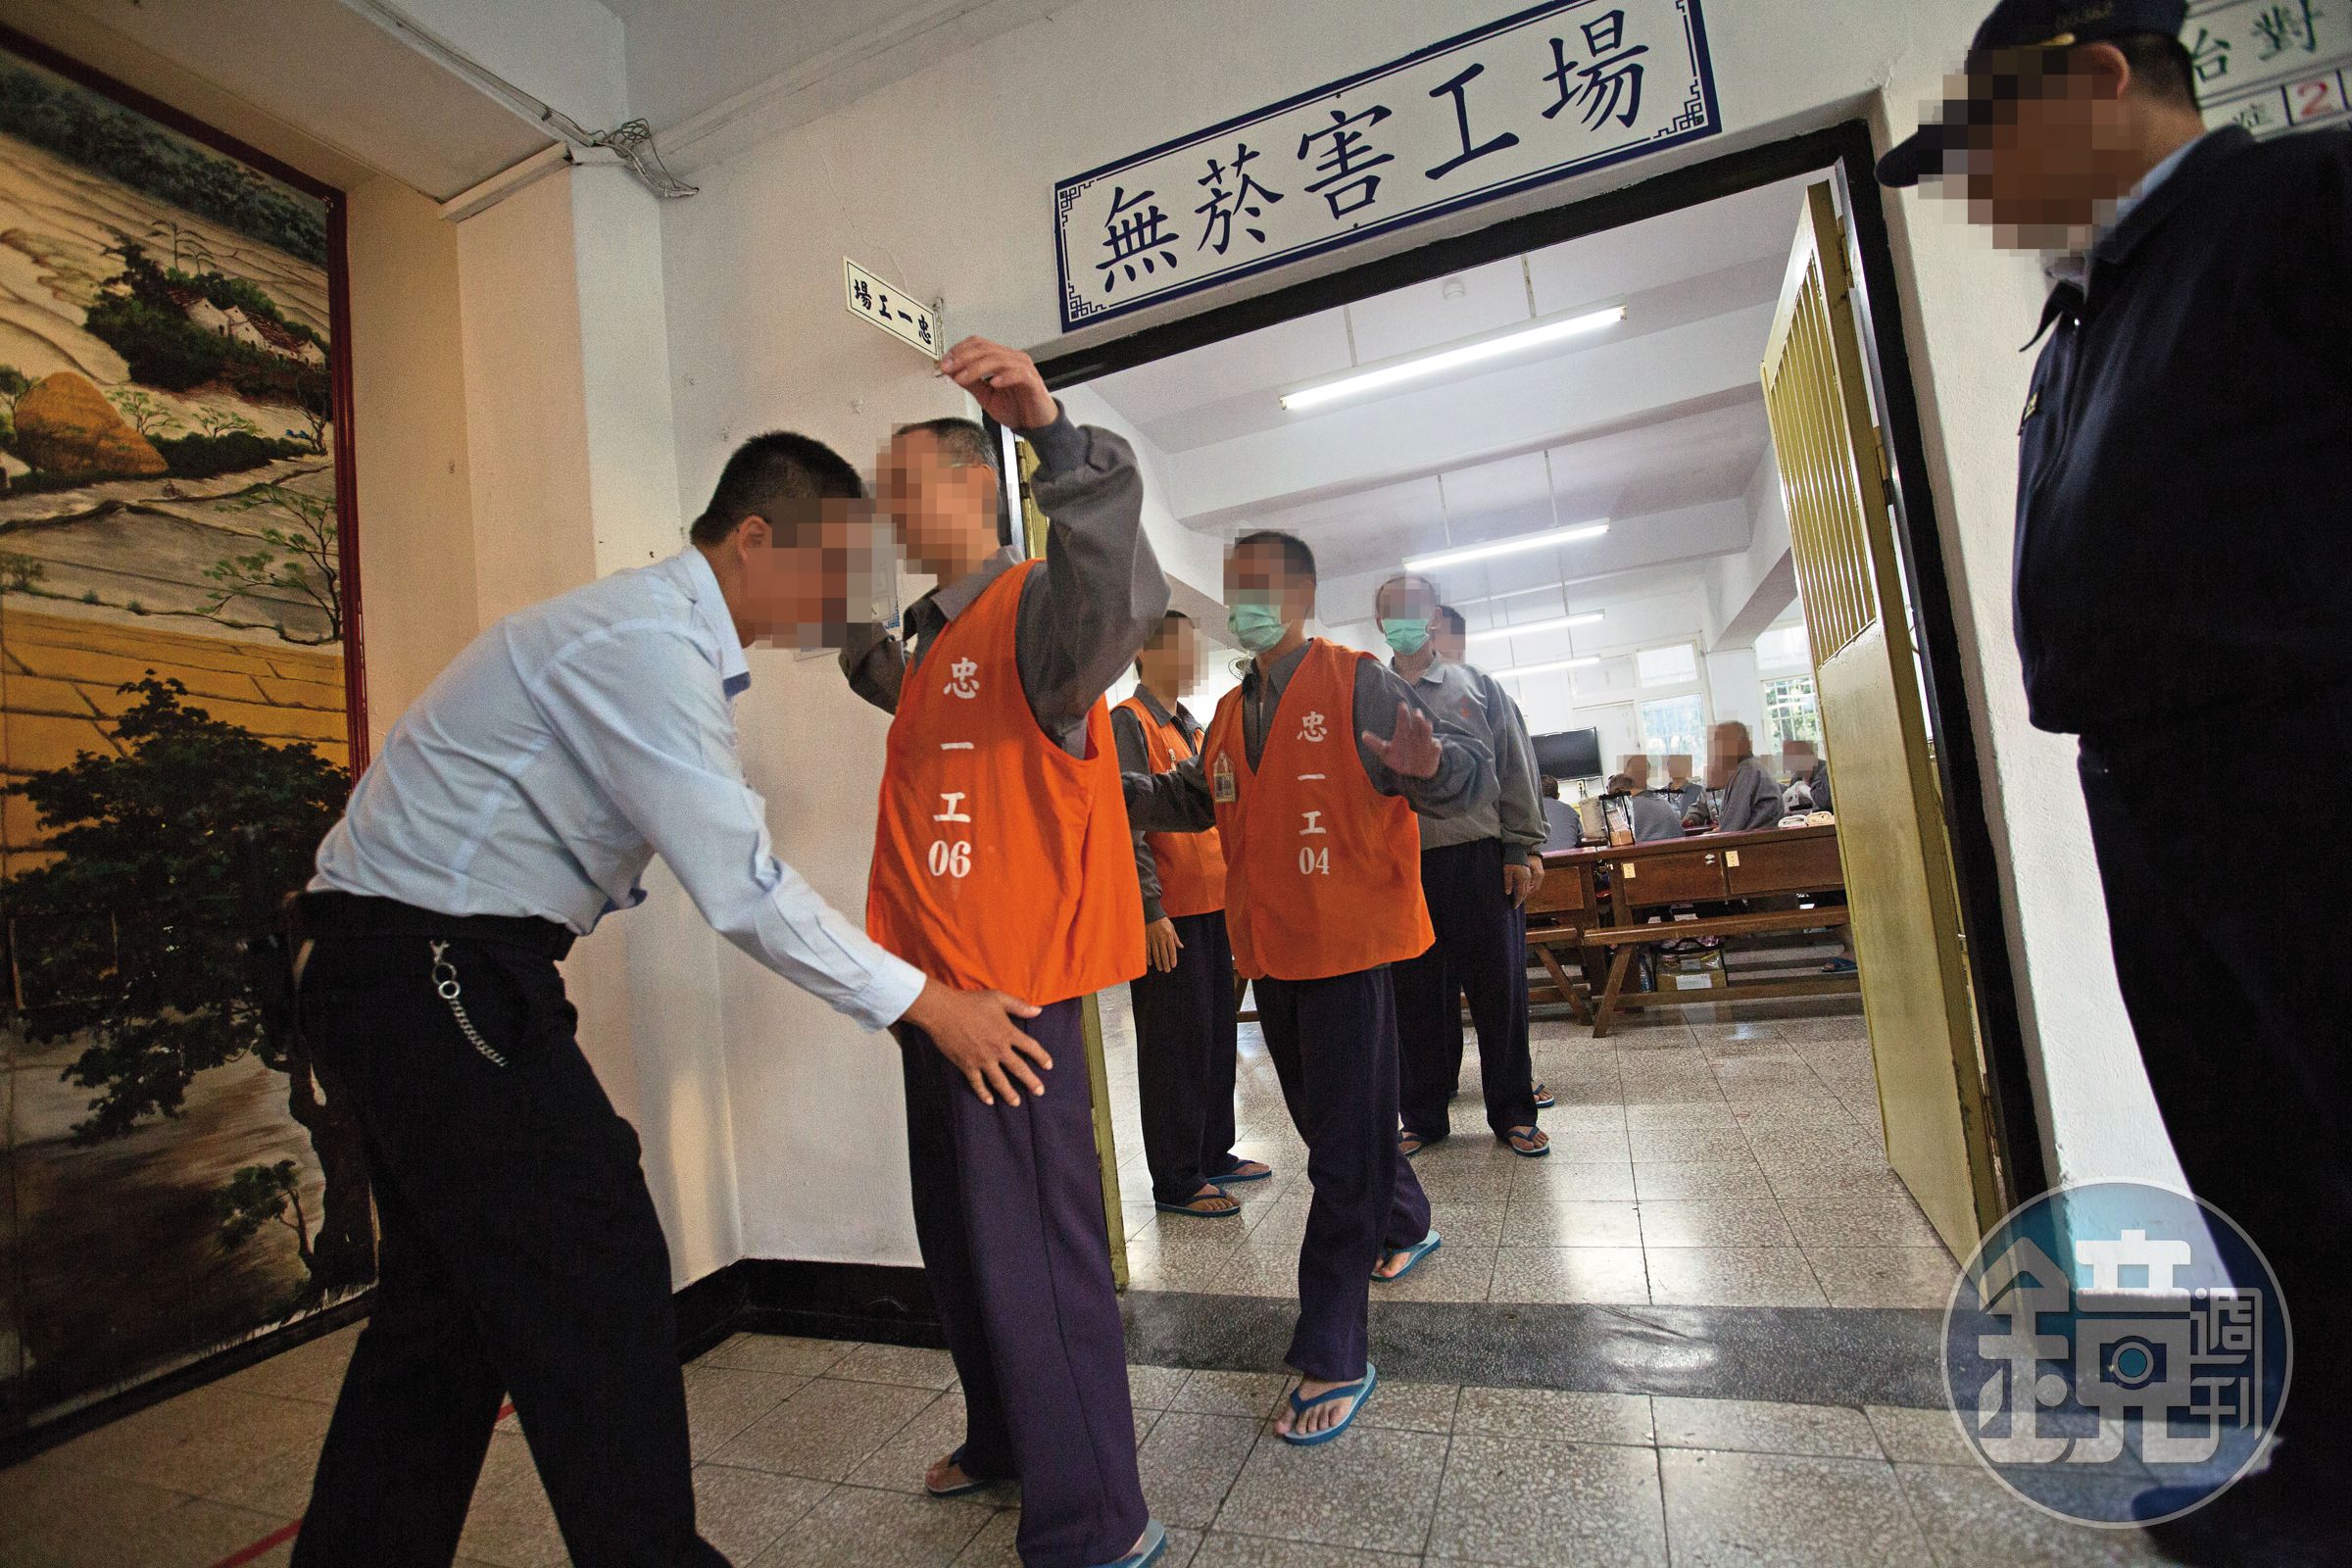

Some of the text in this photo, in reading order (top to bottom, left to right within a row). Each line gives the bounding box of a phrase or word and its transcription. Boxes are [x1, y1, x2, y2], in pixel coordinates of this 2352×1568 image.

[1096, 9, 1649, 292] 無菸害工場
[2297, 81, 2331, 118] 2
